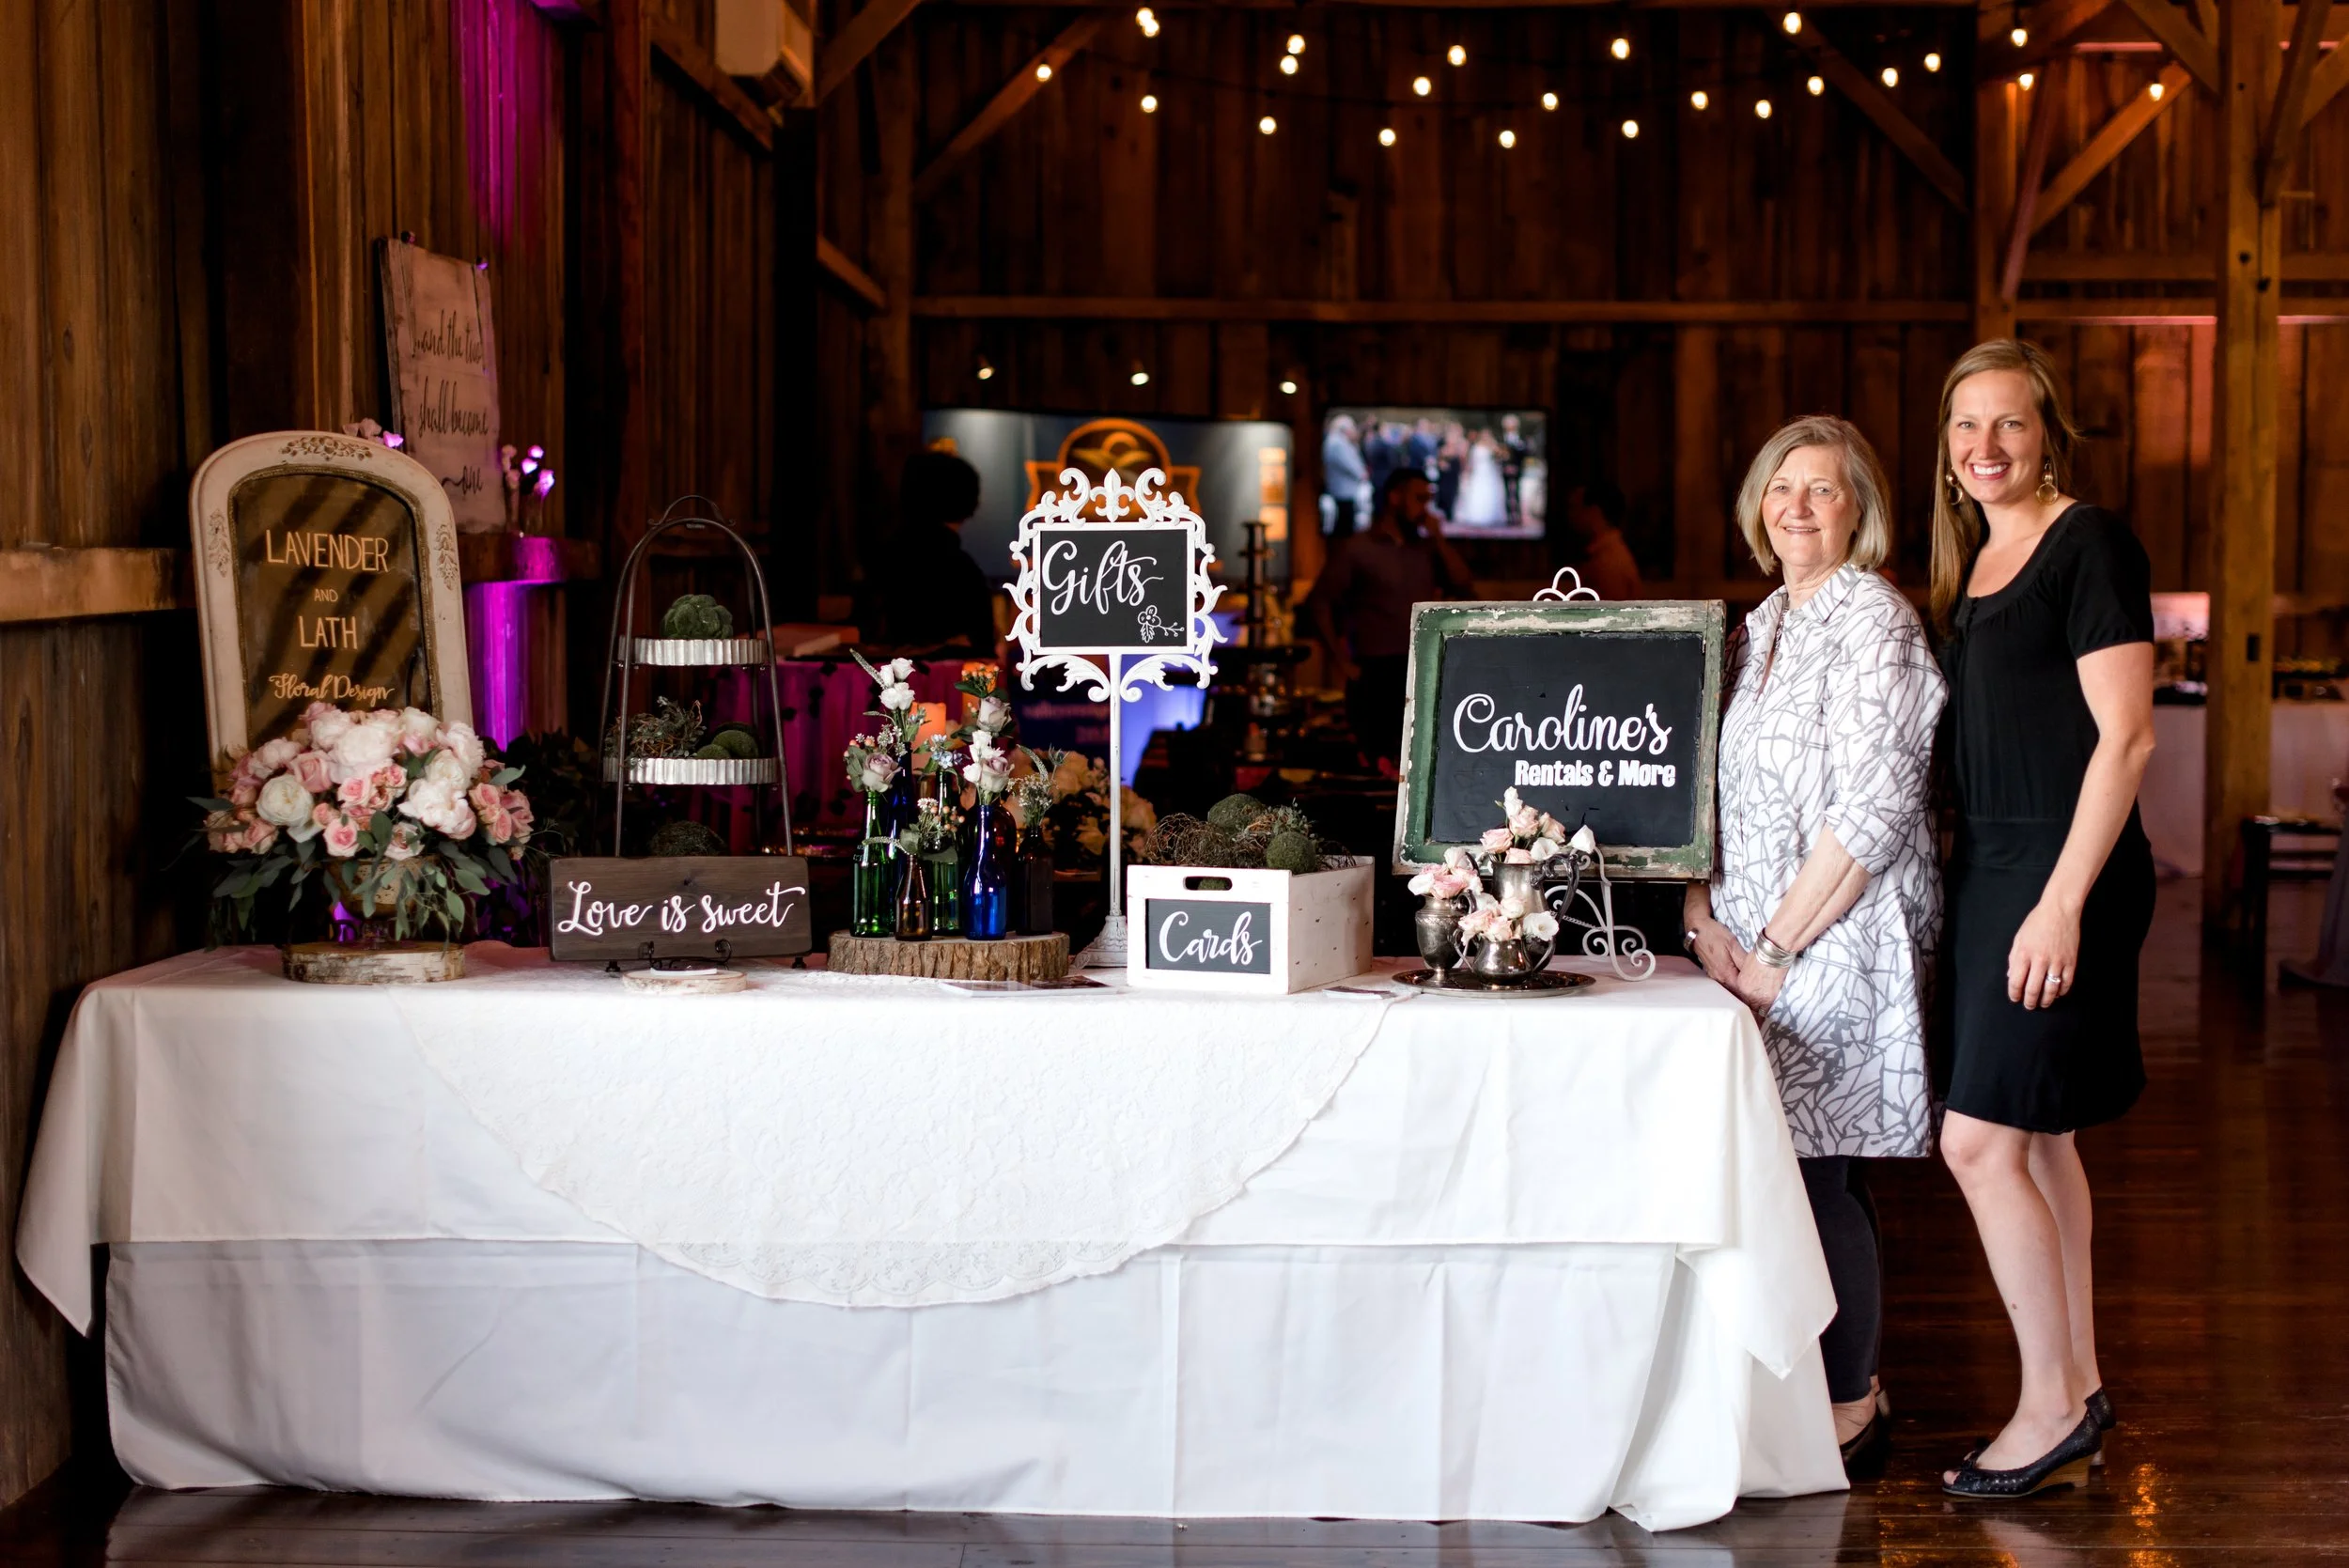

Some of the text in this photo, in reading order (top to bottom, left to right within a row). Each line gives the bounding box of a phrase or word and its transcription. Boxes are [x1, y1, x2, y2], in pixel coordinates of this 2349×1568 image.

[265, 529, 390, 573] LAVENDER
[313, 588, 339, 603] AND
[1042, 539, 1164, 615] Gifts
[298, 615, 359, 650] LATH
[268, 673, 396, 707] Floral Design
[1453, 683, 1672, 755] Caroline's
[1514, 759, 1676, 788] Rentals & More
[557, 880, 806, 937] Love is sweet
[1159, 910, 1263, 966] Cards
